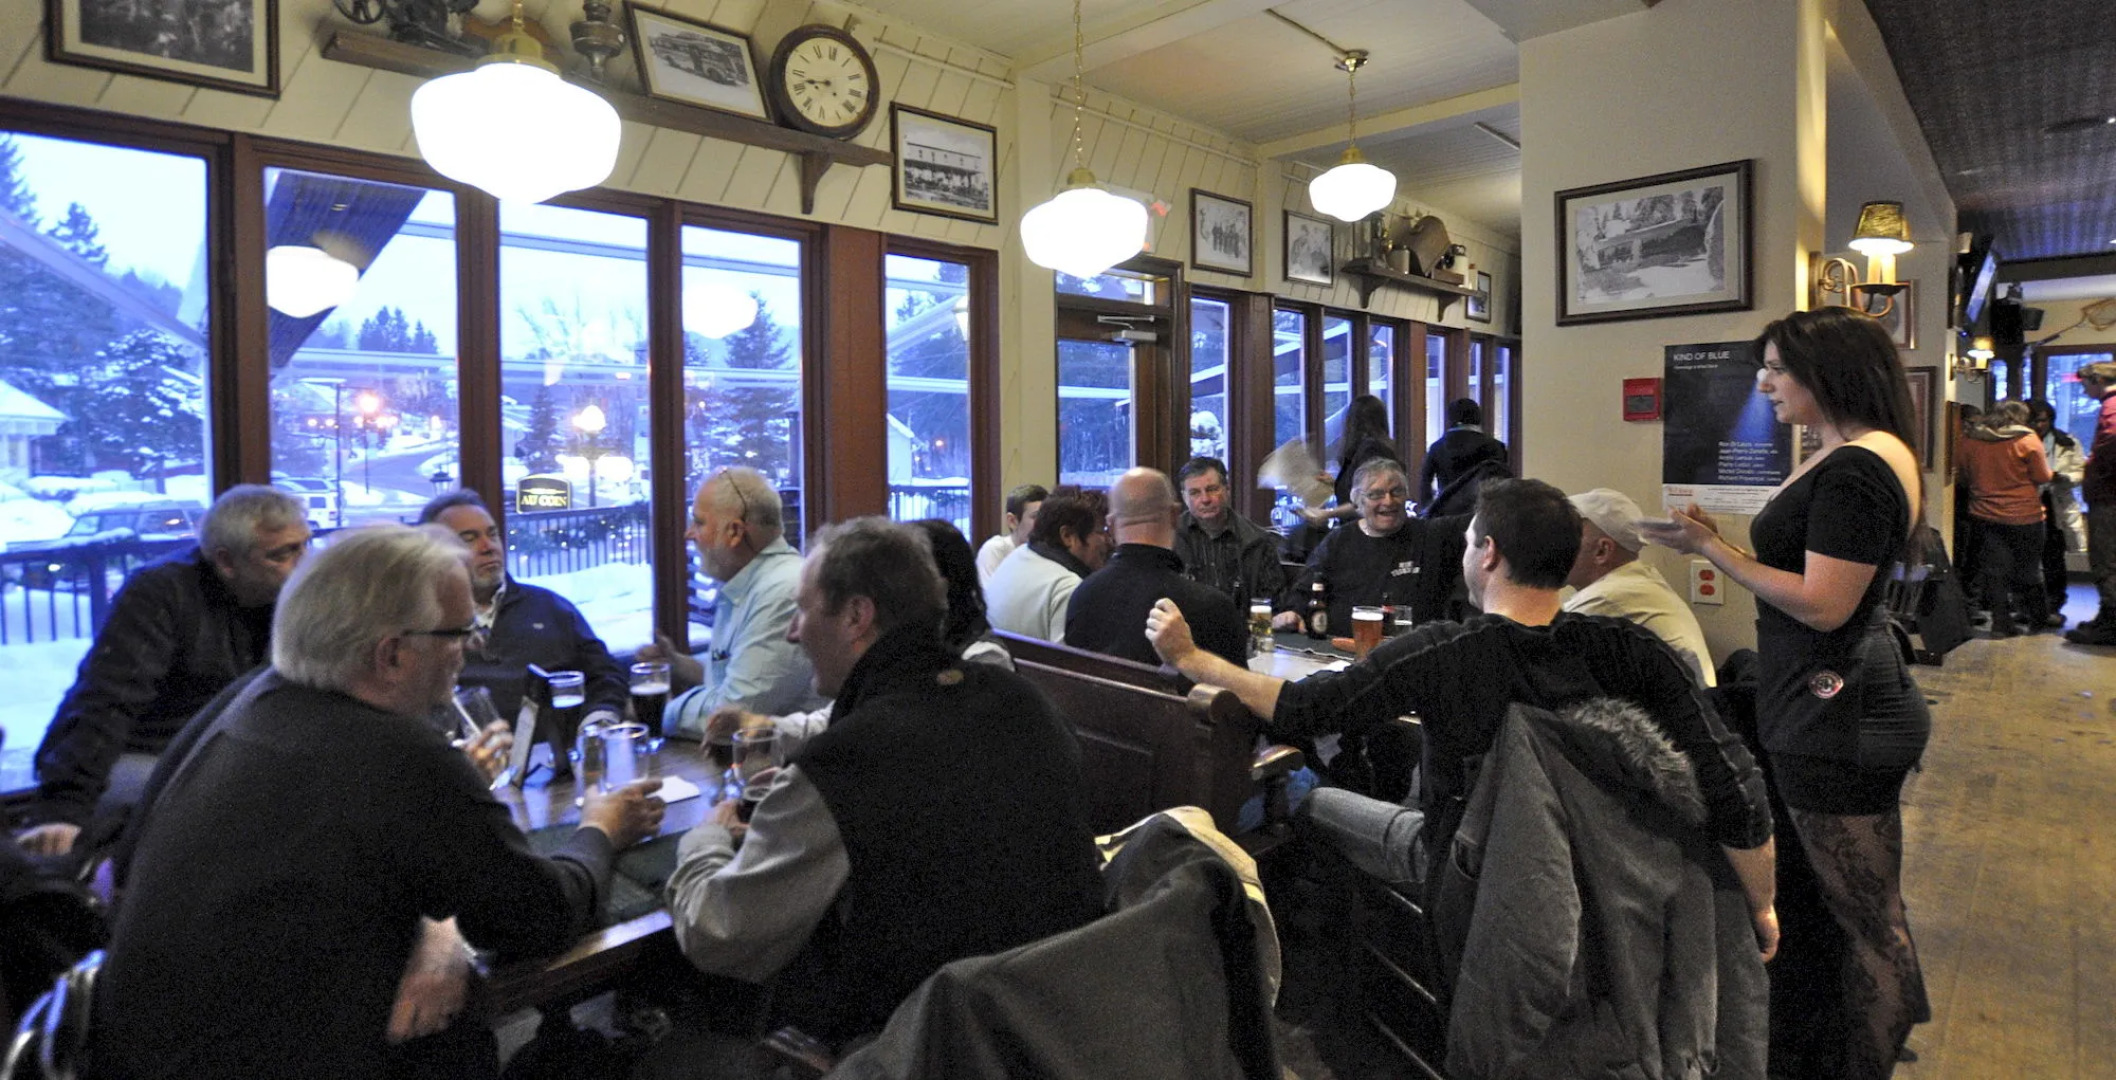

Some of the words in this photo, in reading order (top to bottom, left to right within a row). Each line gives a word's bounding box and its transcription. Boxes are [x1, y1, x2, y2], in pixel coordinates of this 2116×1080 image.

[1673, 352, 1693, 361] KIND
[1694, 352, 1706, 360] OF
[1708, 350, 1731, 360] BLUE
[521, 495, 538, 505] AU
[538, 495, 568, 506] COIN
